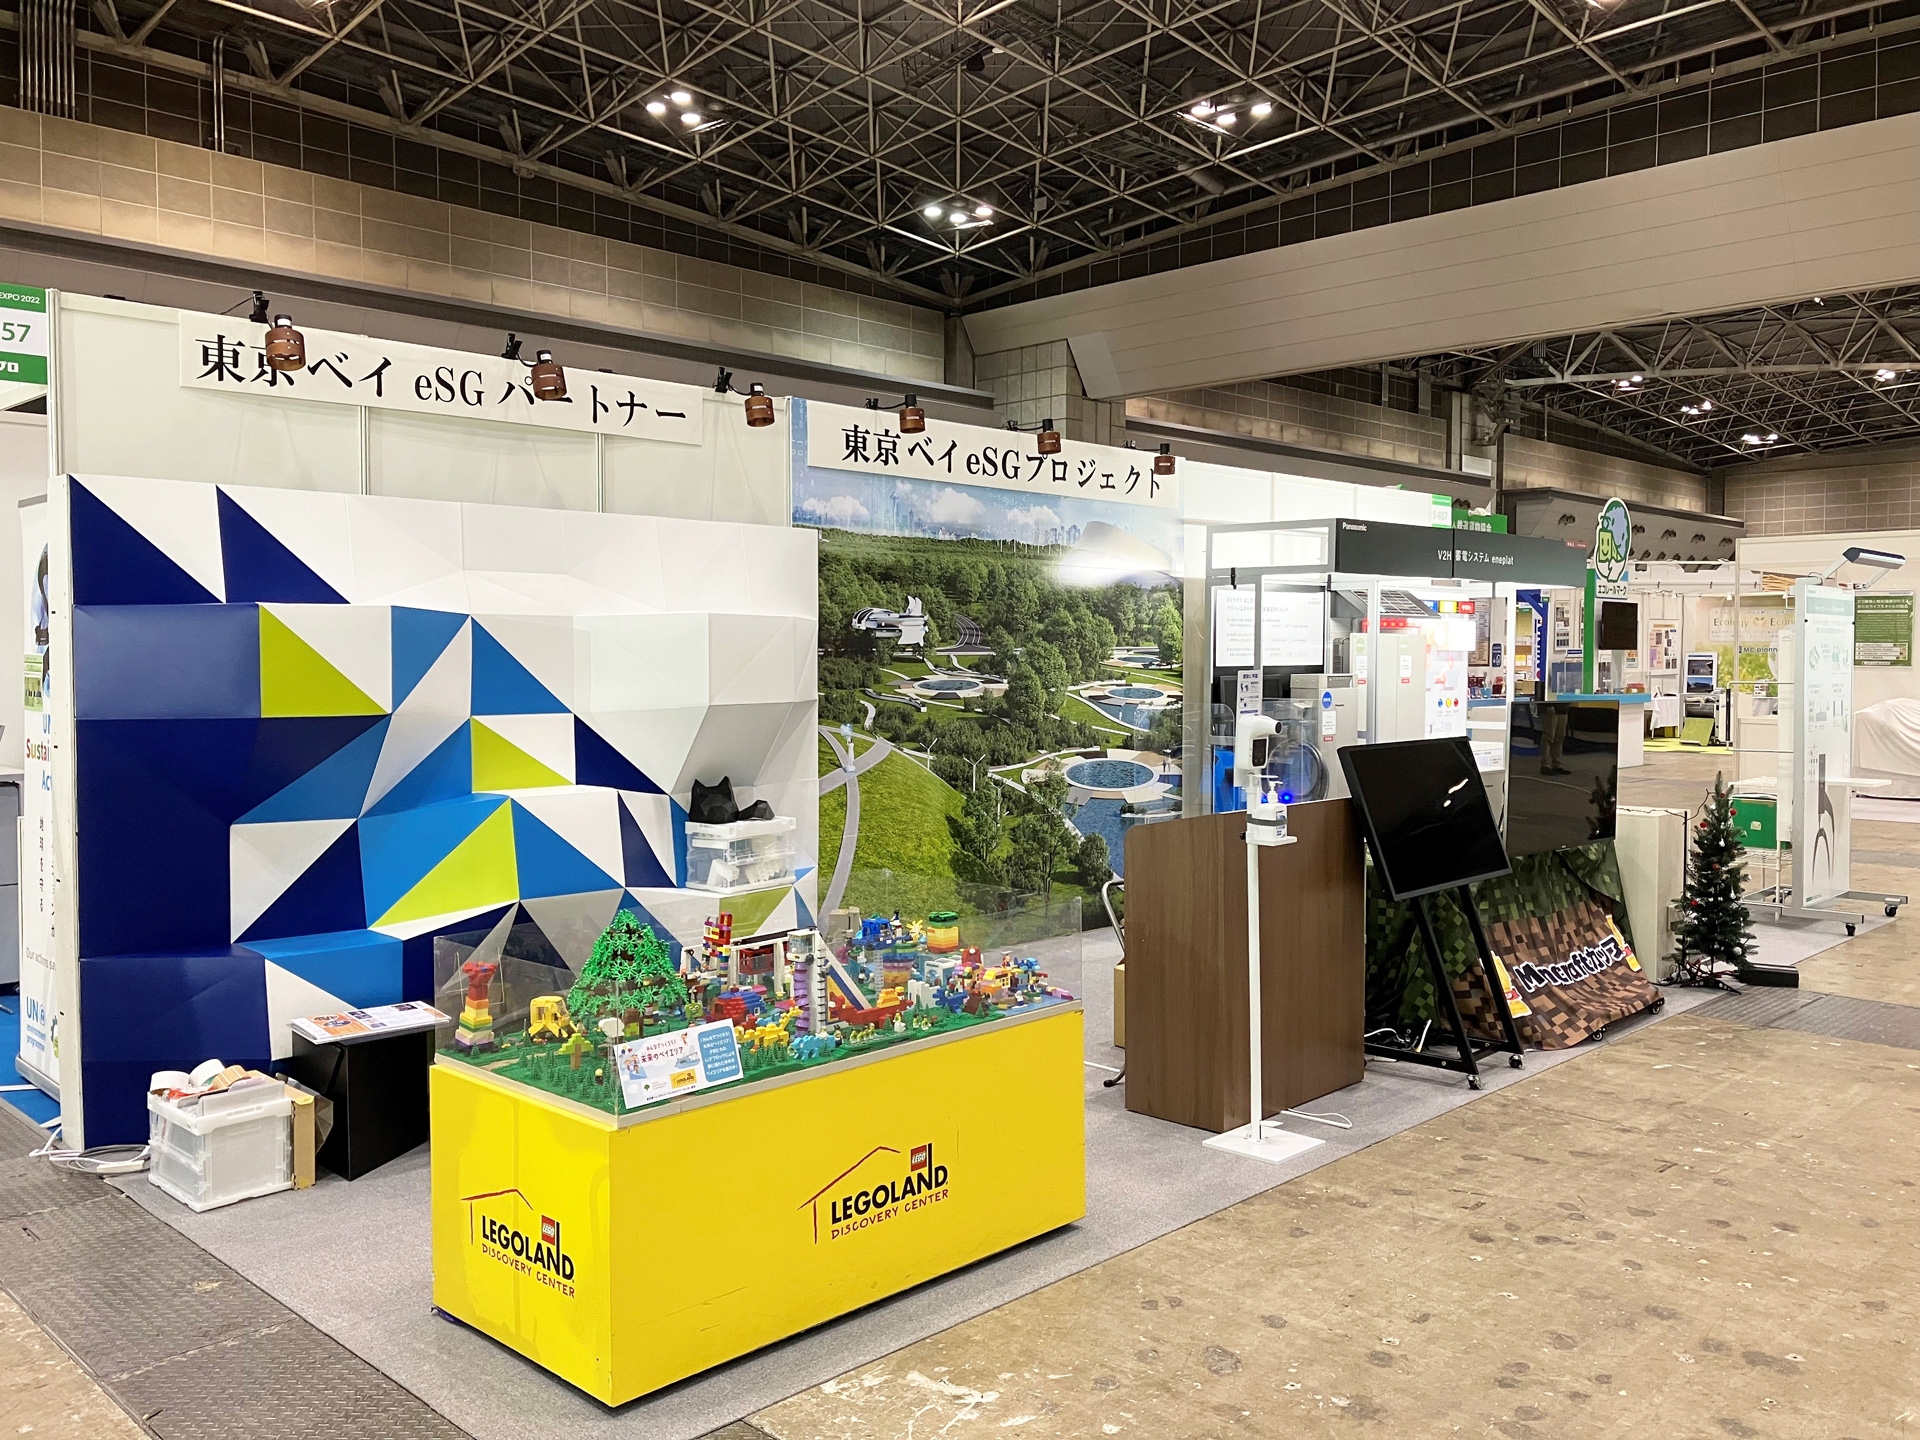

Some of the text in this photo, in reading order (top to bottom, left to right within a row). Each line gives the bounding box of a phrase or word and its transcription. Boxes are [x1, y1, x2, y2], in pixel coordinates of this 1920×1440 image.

[21, 295, 41, 304] 2022
[1, 322, 31, 343] 57
[414, 366, 485, 407] eSG
[1342, 521, 1367, 532] Panasonic
[1437, 549, 1452, 561] V2H
[1491, 555, 1514, 566] eneplat
[1597, 584, 1627, 596] エコレールマーク
[26, 996, 39, 1023] UN
[912, 1152, 926, 1165] LEGO
[831, 1142, 949, 1225] LEGOLAND
[831, 1189, 949, 1240] DISCOVERY CENTER
[482, 1215, 575, 1281] LEGOLAND
[482, 1243, 575, 1299] DISCOVERY CENTER
